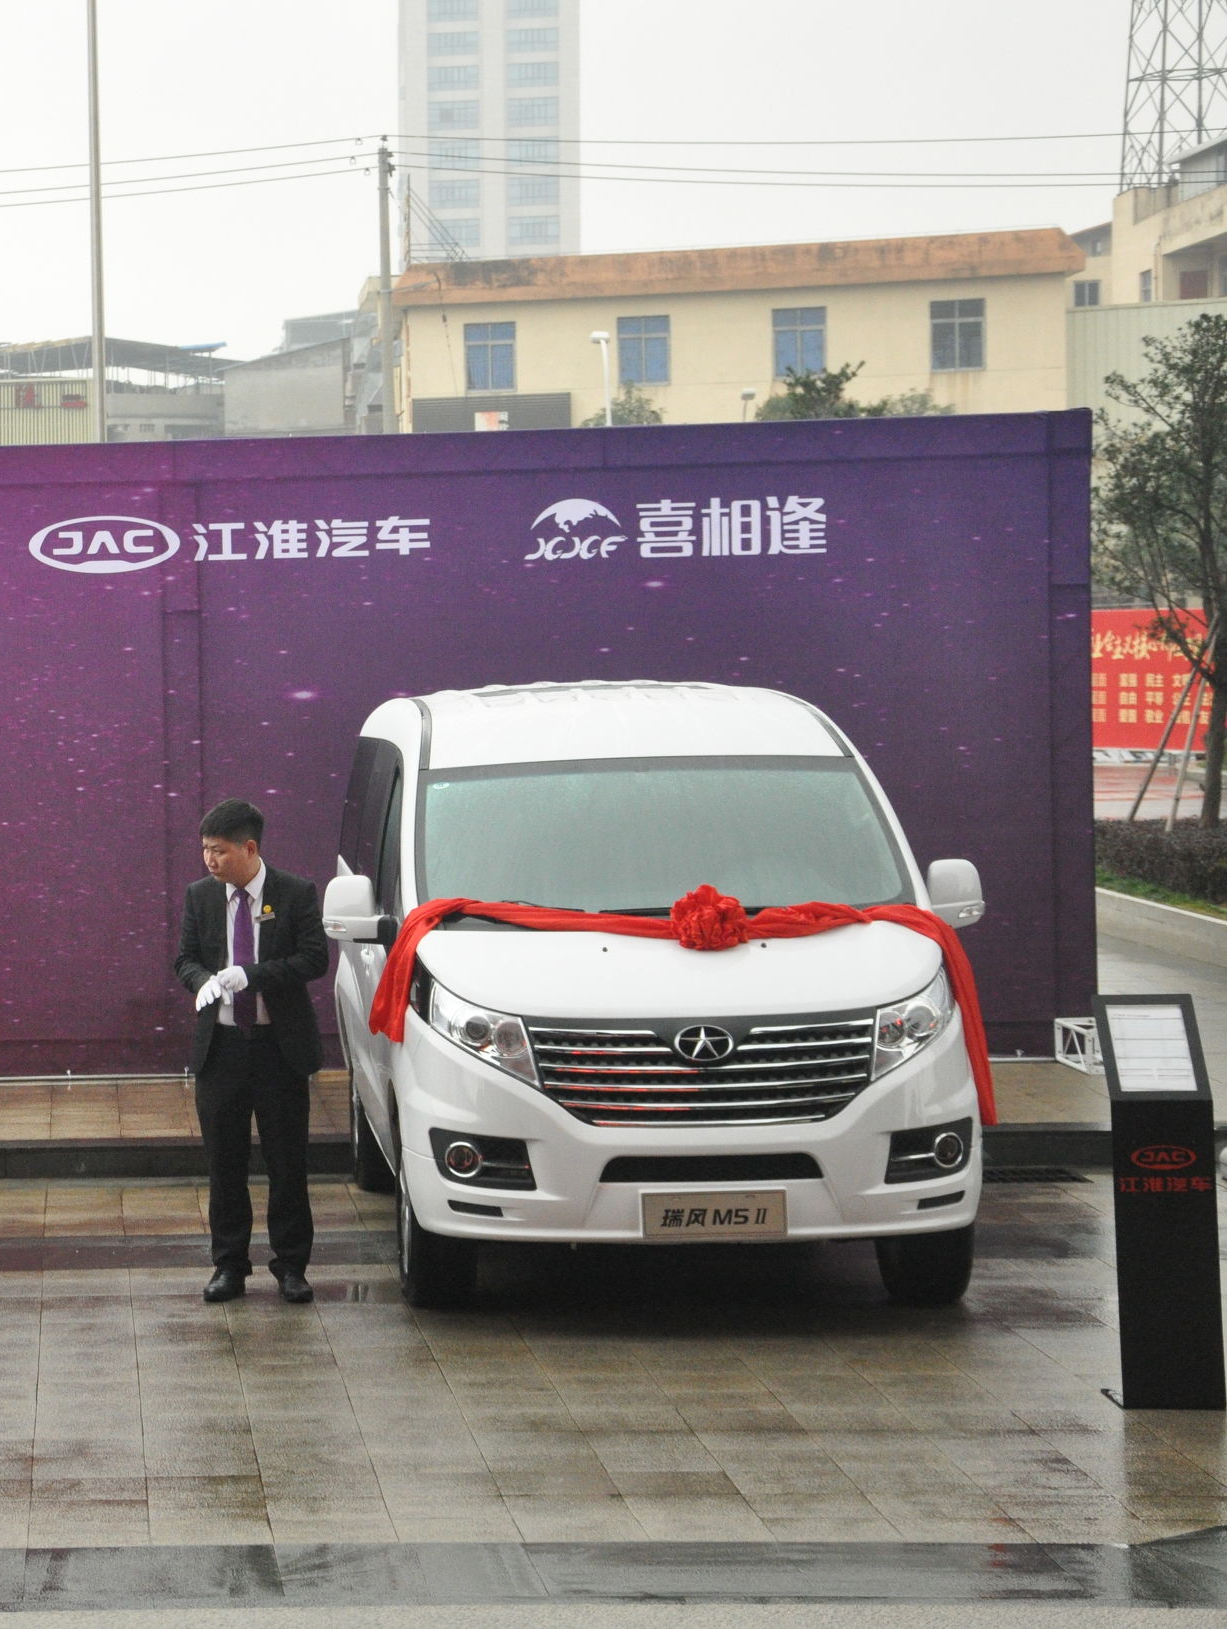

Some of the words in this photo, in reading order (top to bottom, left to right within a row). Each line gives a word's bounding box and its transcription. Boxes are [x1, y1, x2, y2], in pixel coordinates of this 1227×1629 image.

[191, 515, 431, 562] 江淮汽车
[635, 495, 828, 558] 喜相逢
[1118, 1175, 1214, 1193] 江淮汽车
